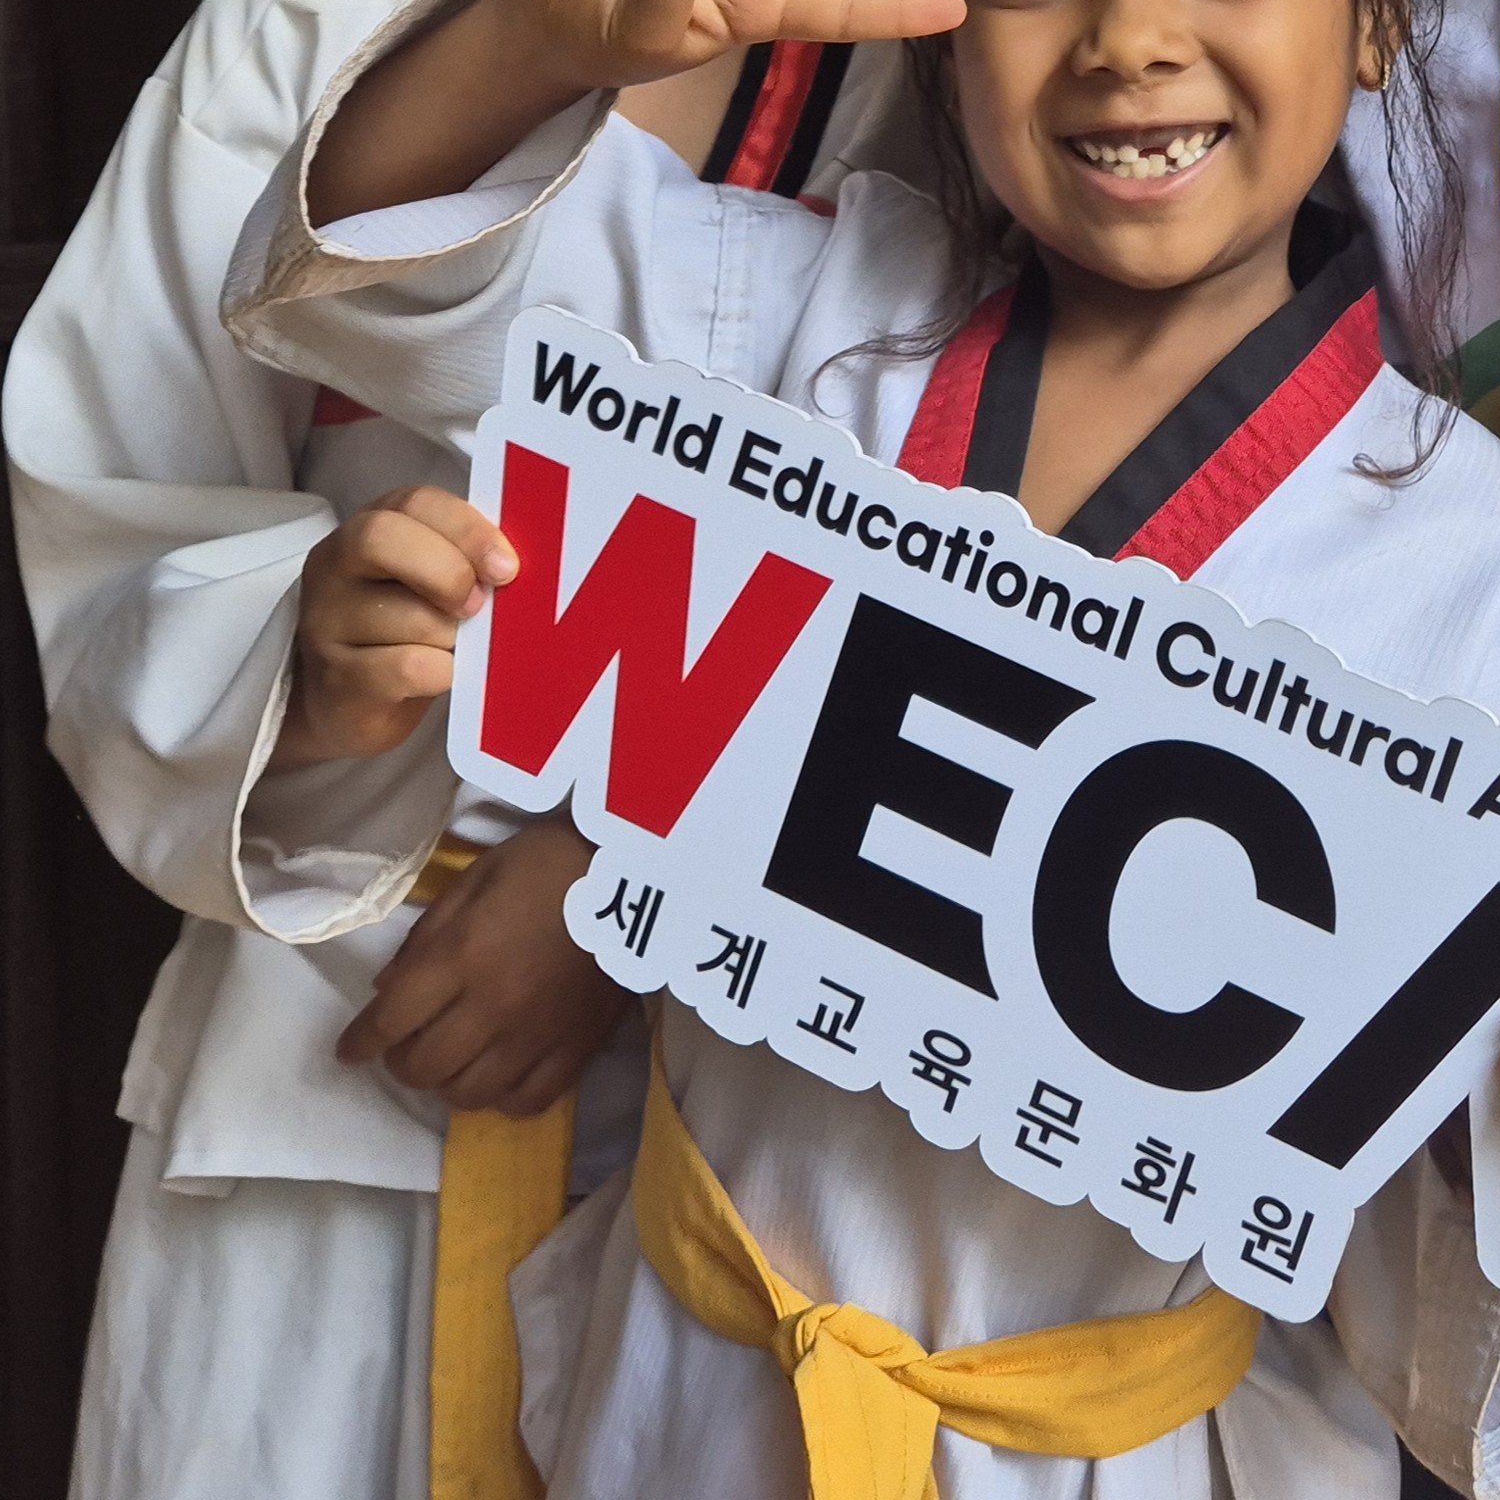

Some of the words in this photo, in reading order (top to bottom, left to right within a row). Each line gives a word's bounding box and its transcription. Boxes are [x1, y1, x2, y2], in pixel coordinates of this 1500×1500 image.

[534, 340, 724, 474] World
[728, 429, 1144, 662] Educational
[1155, 620, 1464, 804] Cultural
